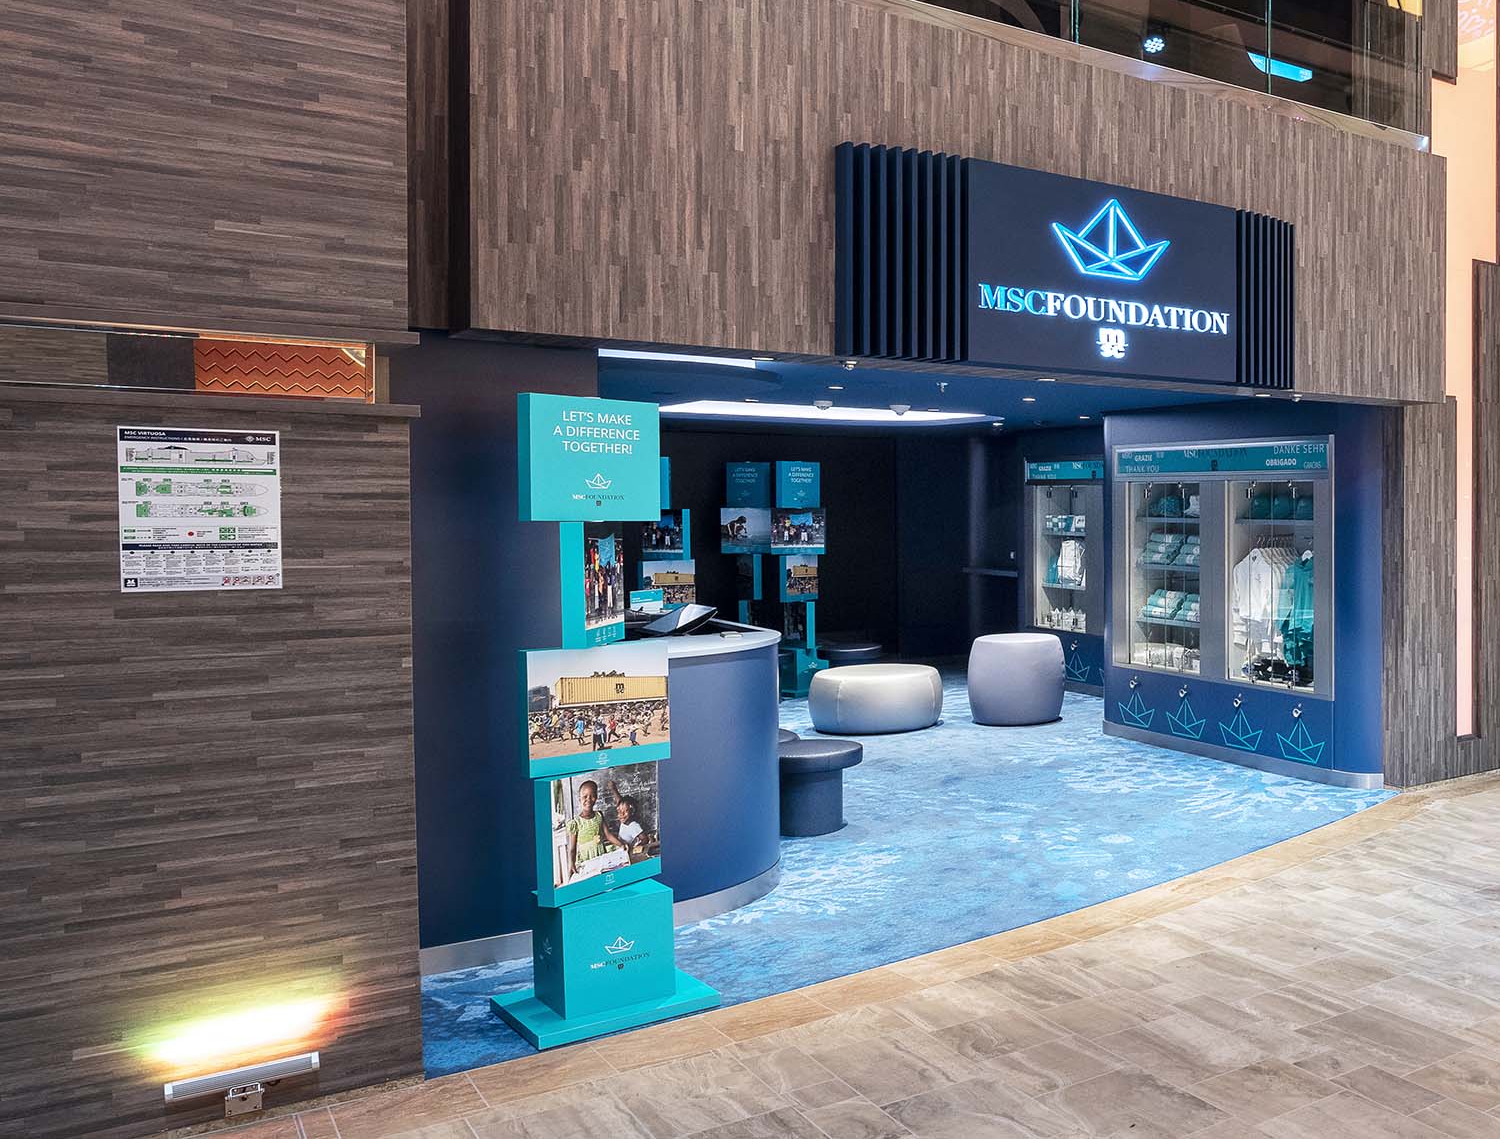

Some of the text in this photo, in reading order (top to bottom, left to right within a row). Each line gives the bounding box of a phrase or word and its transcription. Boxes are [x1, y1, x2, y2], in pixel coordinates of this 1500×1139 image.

[978, 282, 1230, 335] MSCFOUNDATION
[562, 410, 632, 426] LET'S MAKE
[553, 425, 640, 441] A DIFFERENCE
[562, 440, 633, 454] TOGETHER!
[1273, 443, 1325, 455] DANKE SEHR
[1125, 464, 1160, 473] THANK YOU
[1265, 458, 1297, 466] OBRIGADO
